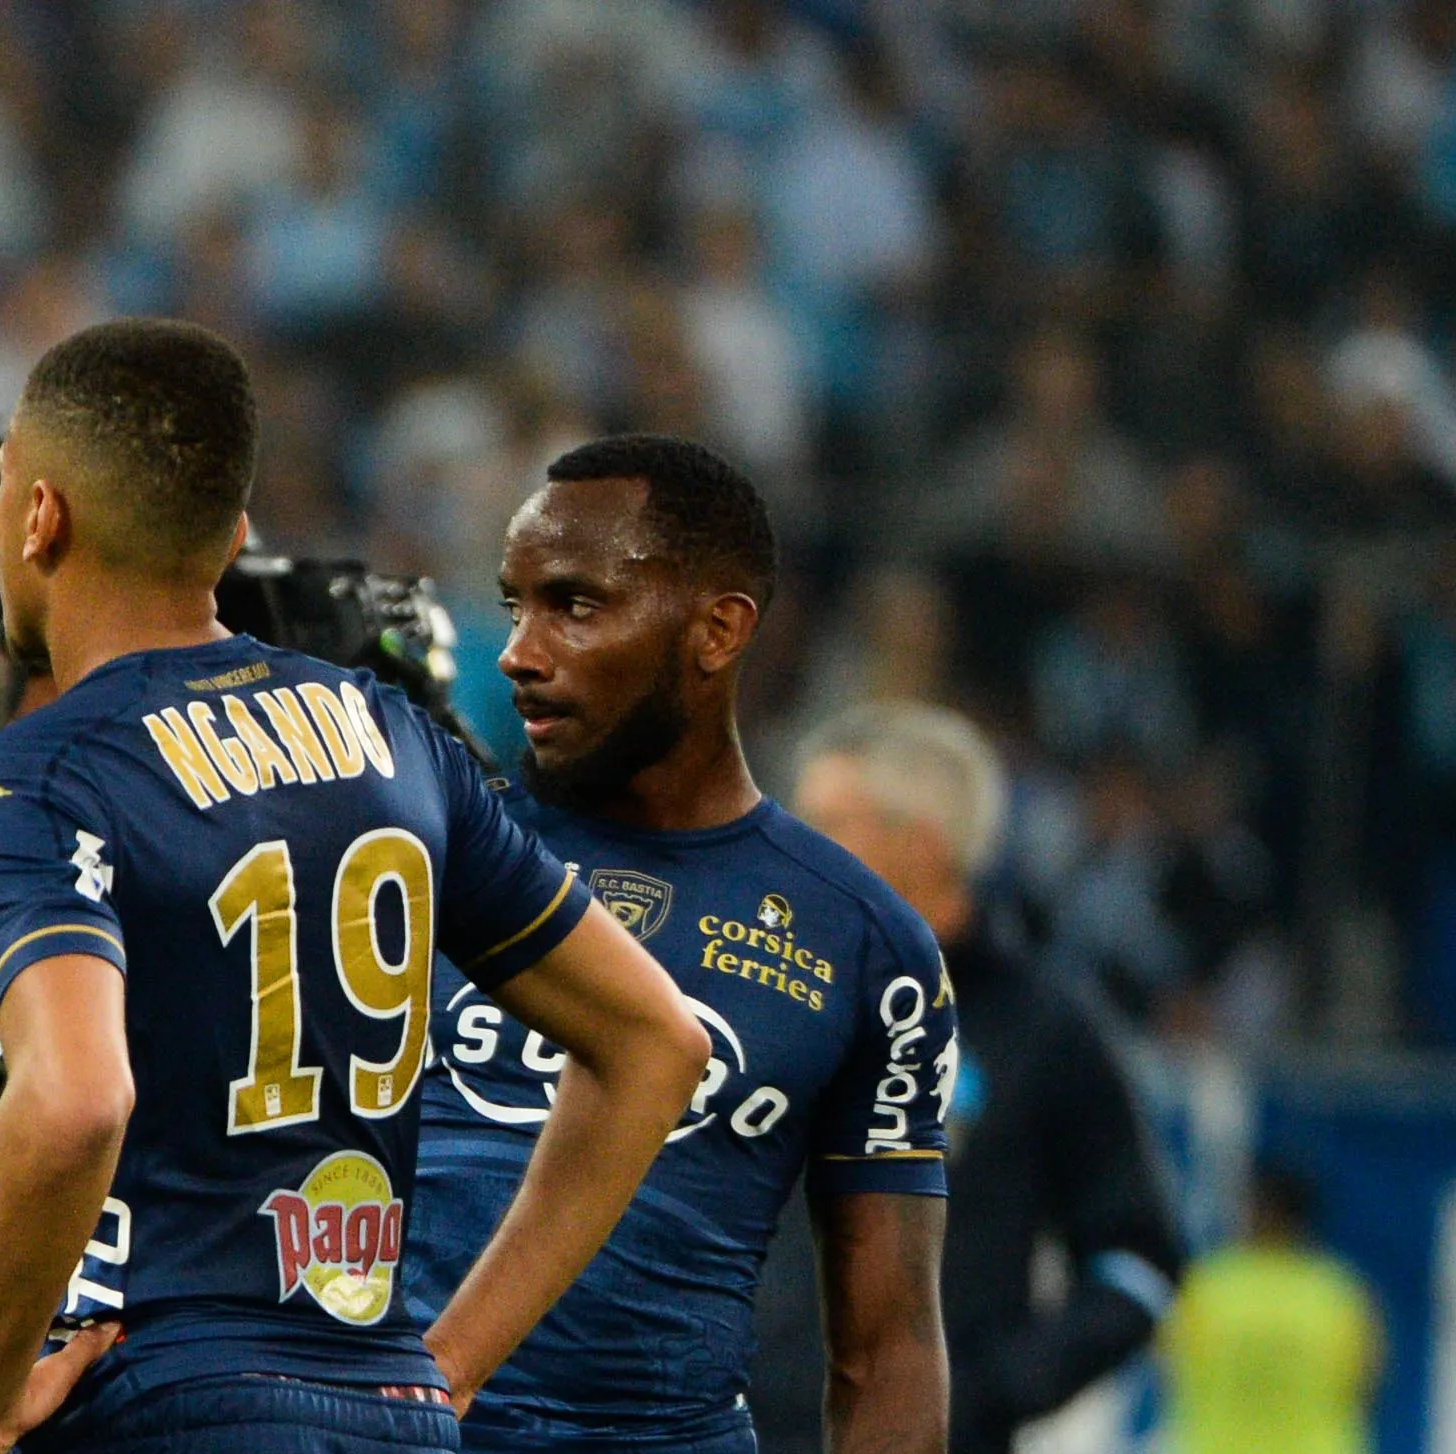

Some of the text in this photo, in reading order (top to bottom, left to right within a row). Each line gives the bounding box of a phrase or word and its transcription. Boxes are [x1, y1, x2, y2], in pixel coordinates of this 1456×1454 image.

[141, 680, 395, 811] NGANDO
[207, 826, 434, 1137] 19
[697, 914, 834, 985] corsica
[700, 938, 826, 1012] ferries
